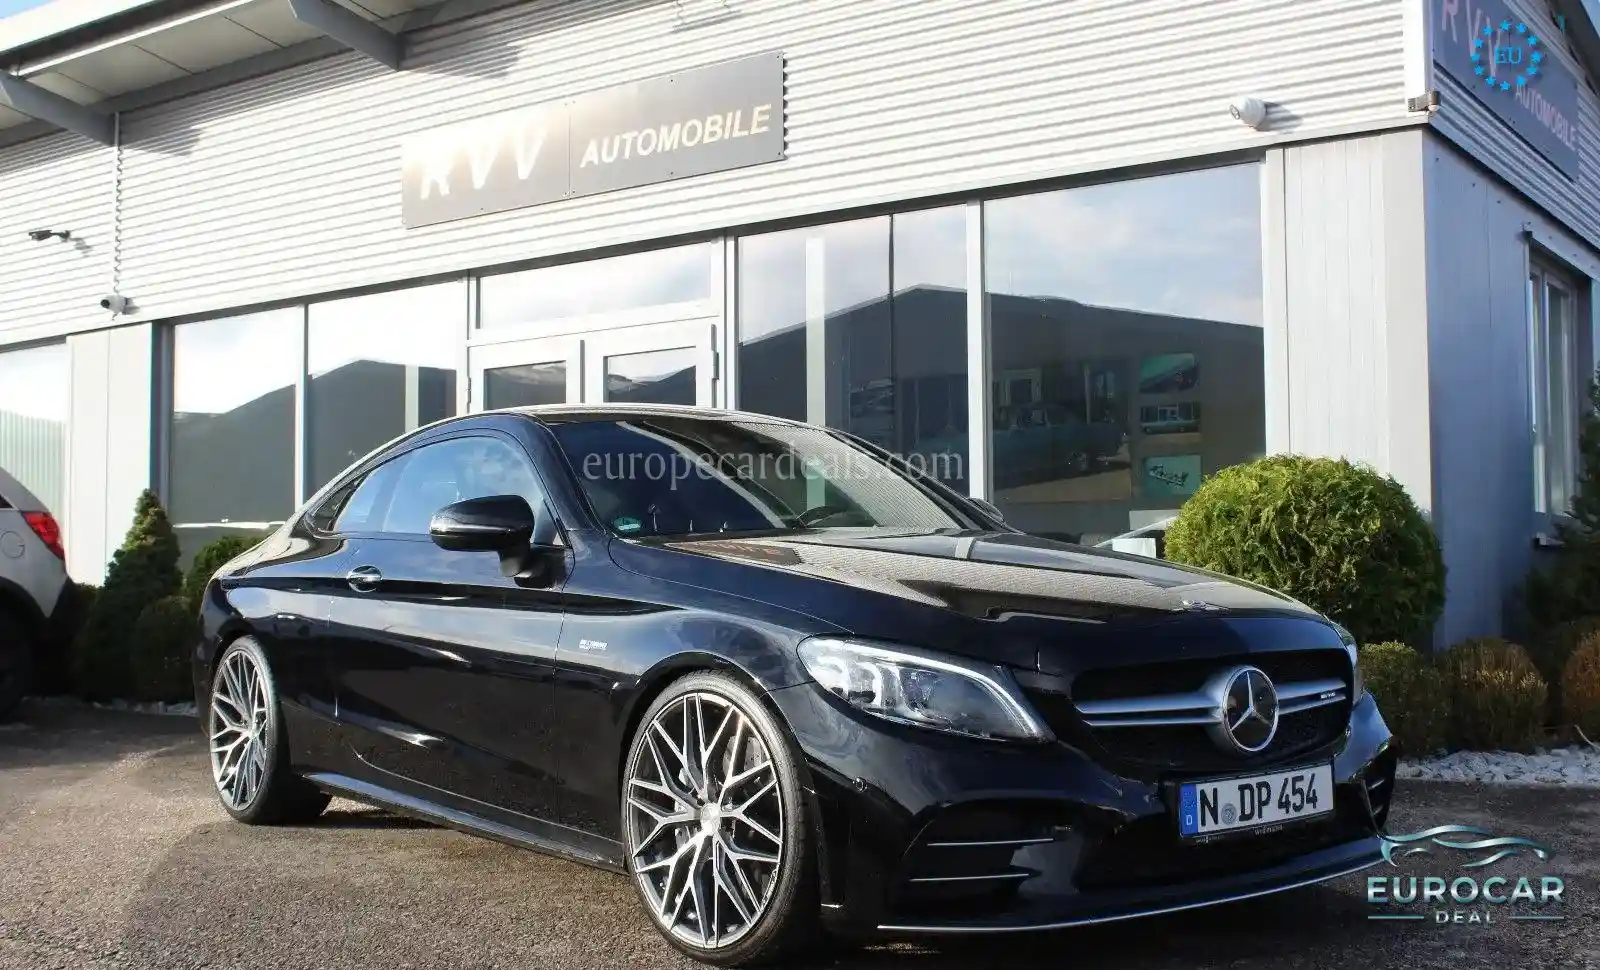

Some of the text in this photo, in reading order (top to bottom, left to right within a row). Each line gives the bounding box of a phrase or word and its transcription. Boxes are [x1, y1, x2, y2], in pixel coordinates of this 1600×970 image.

[580, 103, 772, 168] AUTOMOBILE
[1515, 83, 1577, 151] AUTOMOBILE
[1186, 814, 1193, 826] D
[1199, 773, 1318, 827] N DP 454
